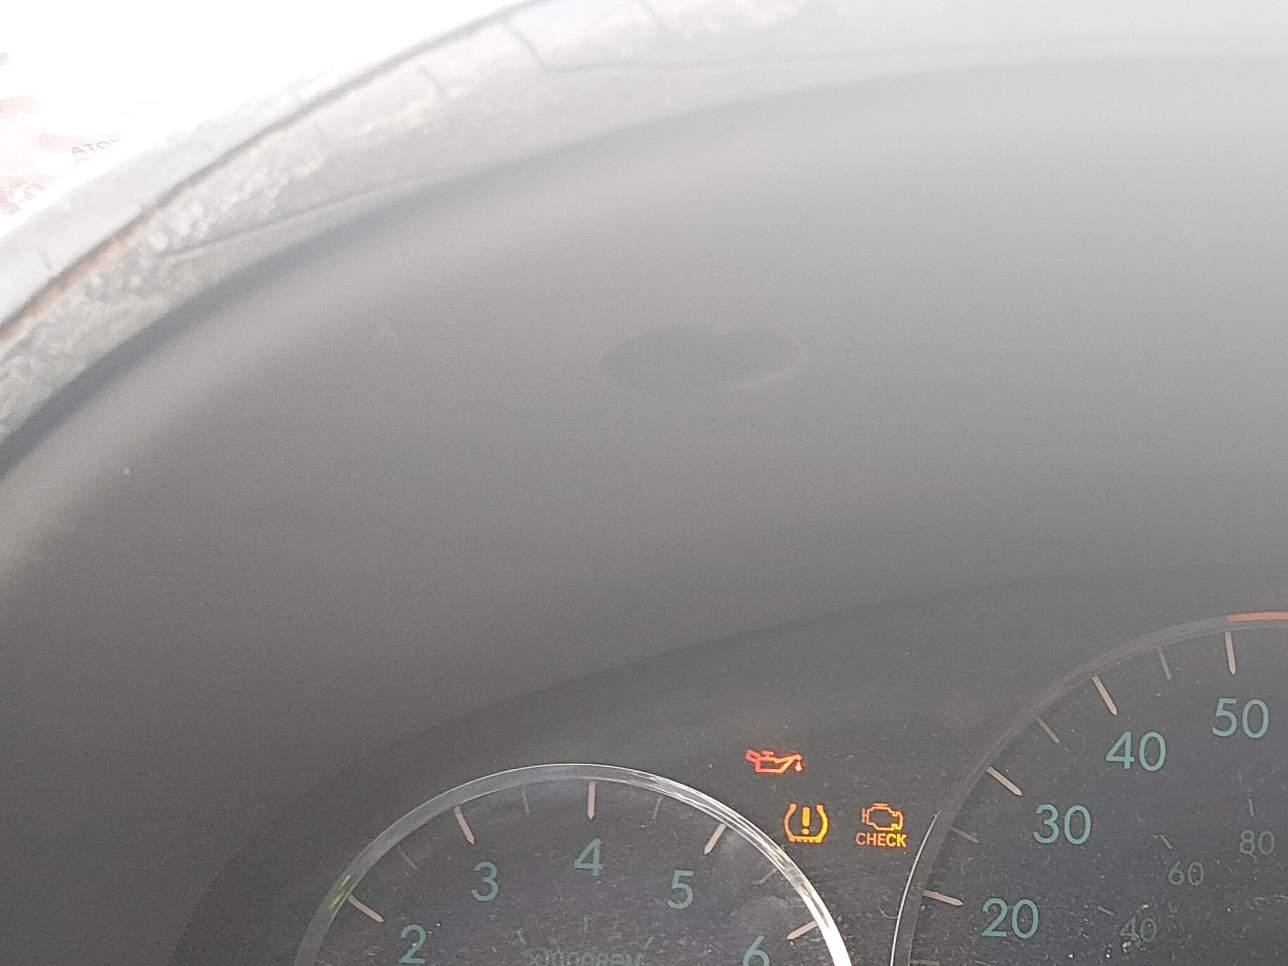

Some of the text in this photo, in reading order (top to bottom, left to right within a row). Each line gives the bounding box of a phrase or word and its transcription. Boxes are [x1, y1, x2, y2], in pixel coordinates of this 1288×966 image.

[1212, 697, 1270, 739] 50
[1105, 731, 1167, 772] 40
[855, 832, 907, 848] CHECK
[1032, 803, 1092, 845] 30
[1239, 830, 1275, 856] 80
[575, 839, 603, 876] 4
[1167, 861, 1204, 886] 60
[471, 861, 498, 902] 3
[667, 870, 694, 910] 5
[981, 898, 1039, 940] 20
[1120, 917, 1157, 943] 40
[399, 924, 426, 964] 2
